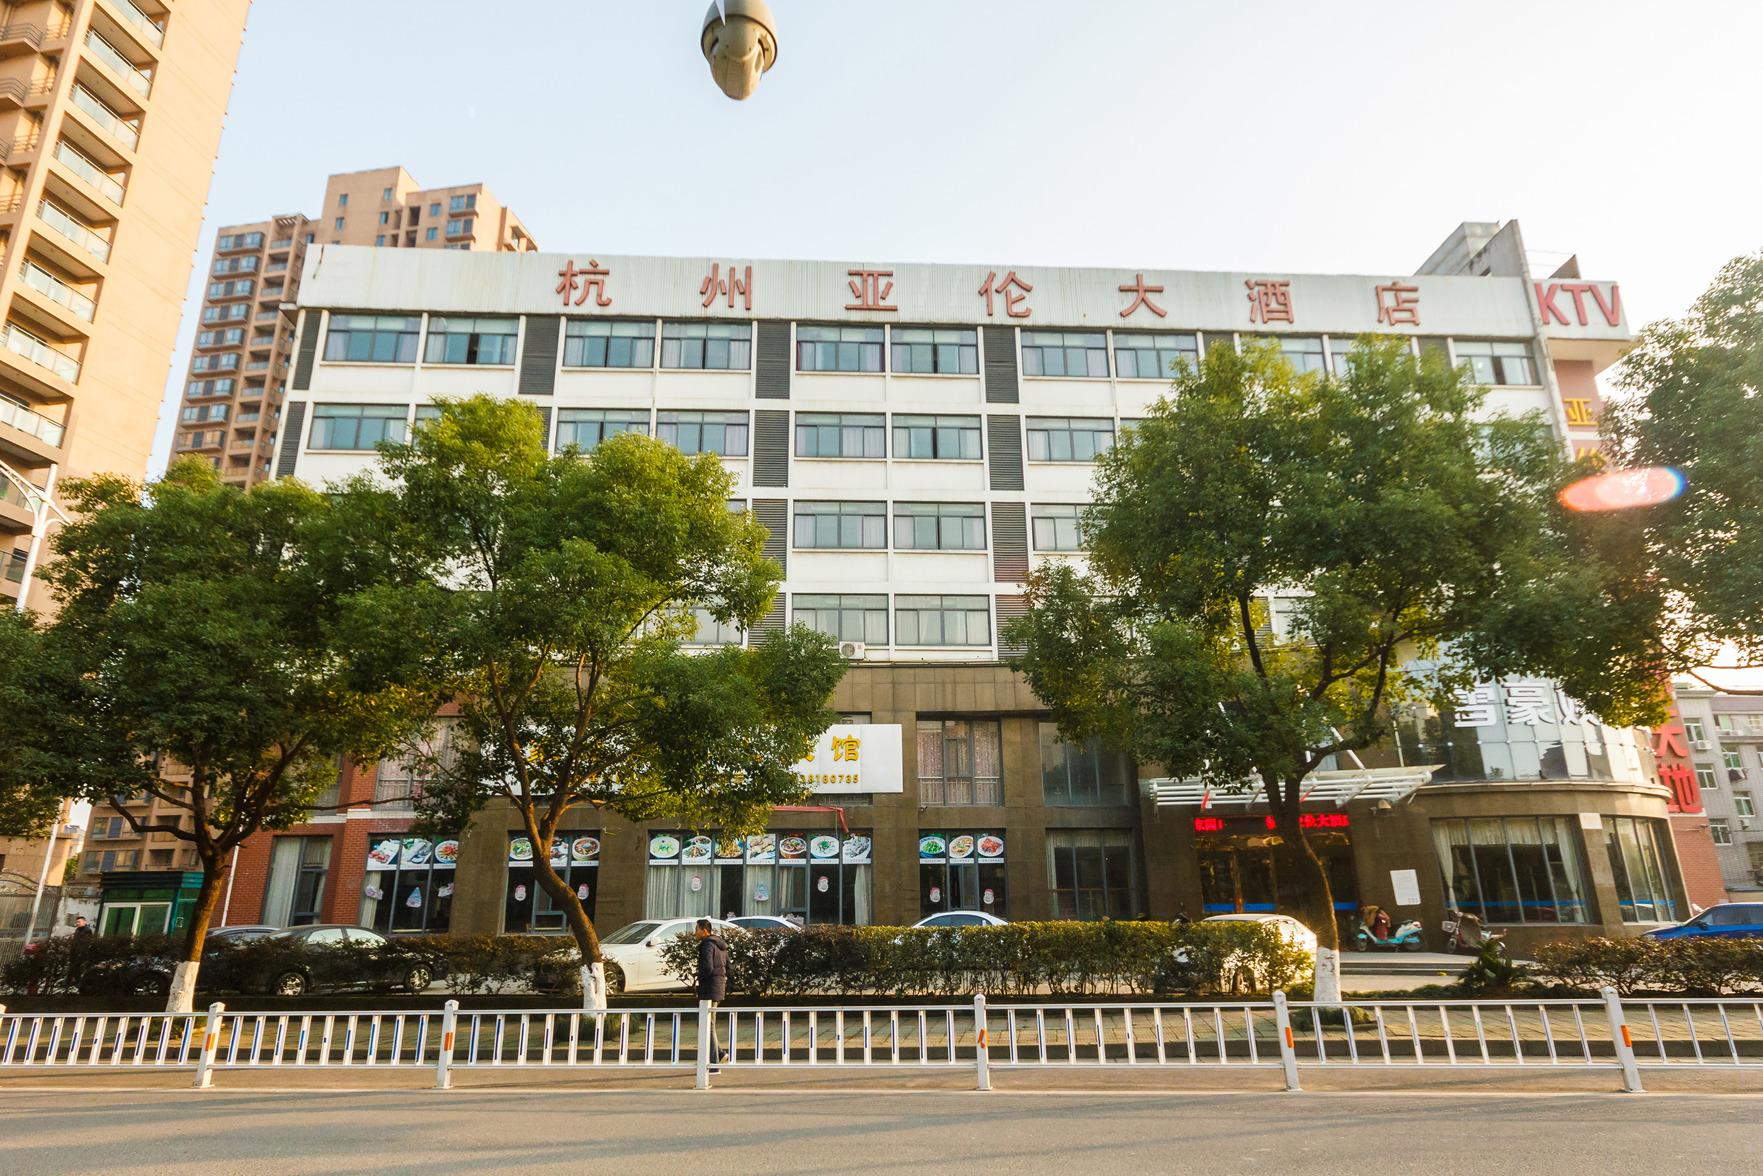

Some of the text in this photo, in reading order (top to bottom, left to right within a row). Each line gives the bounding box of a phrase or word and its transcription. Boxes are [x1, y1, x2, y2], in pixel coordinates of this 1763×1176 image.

[555, 259, 1421, 326] 杭州亚伦大酒店
[1534, 283, 1620, 327] KTV
